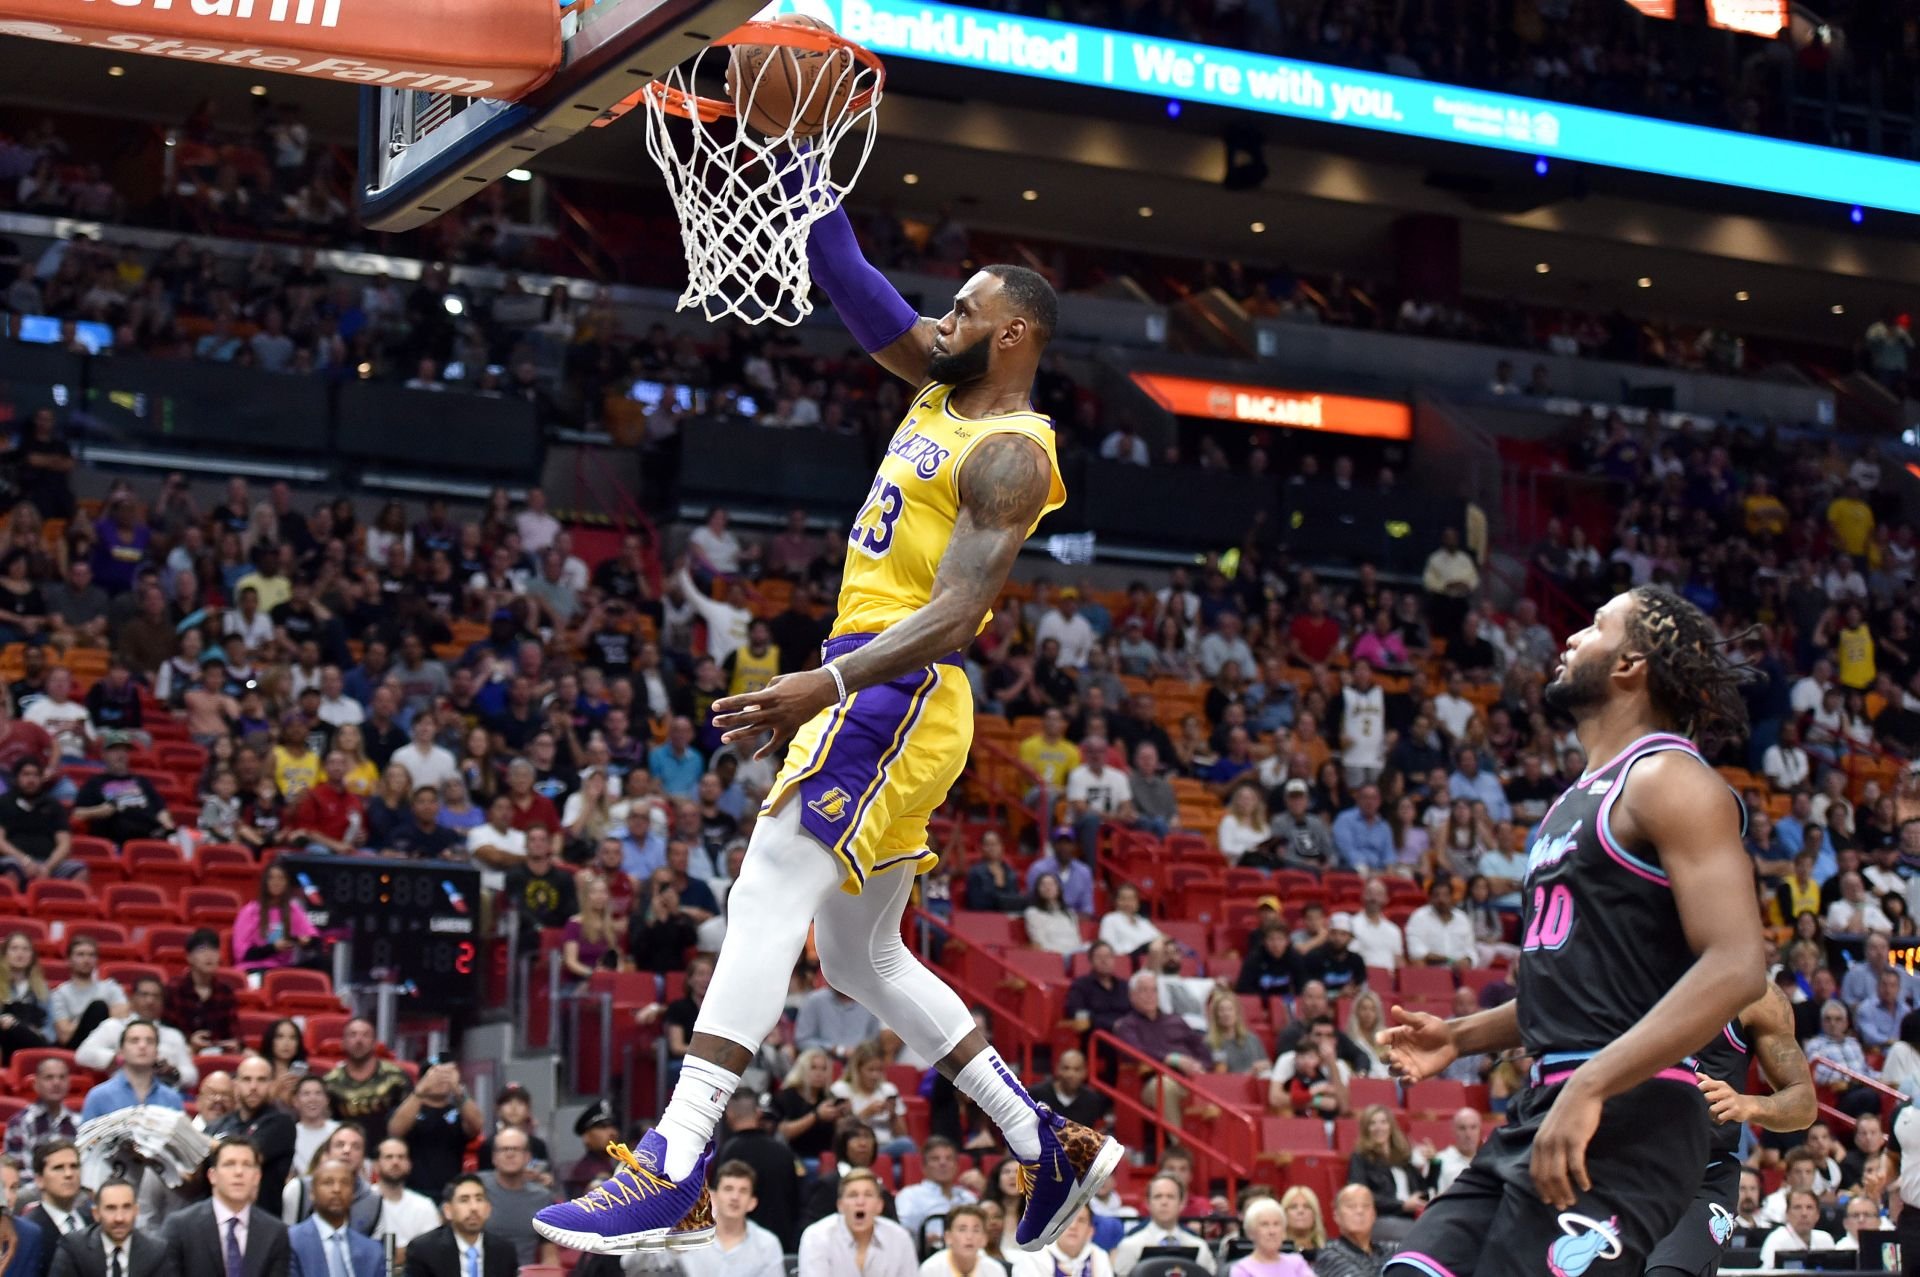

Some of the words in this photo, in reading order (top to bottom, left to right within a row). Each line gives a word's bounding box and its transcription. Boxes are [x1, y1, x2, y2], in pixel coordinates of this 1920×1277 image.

[89, 34, 301, 69] State
[295, 57, 494, 93] Farm
[842, 0, 1078, 74] BankUnited
[1132, 42, 1242, 95] We're
[1246, 66, 1324, 109] with
[885, 418, 950, 480] LAKERS
[848, 473, 904, 558] 23
[1523, 883, 1574, 952] 20
[455, 941, 476, 975] 2
